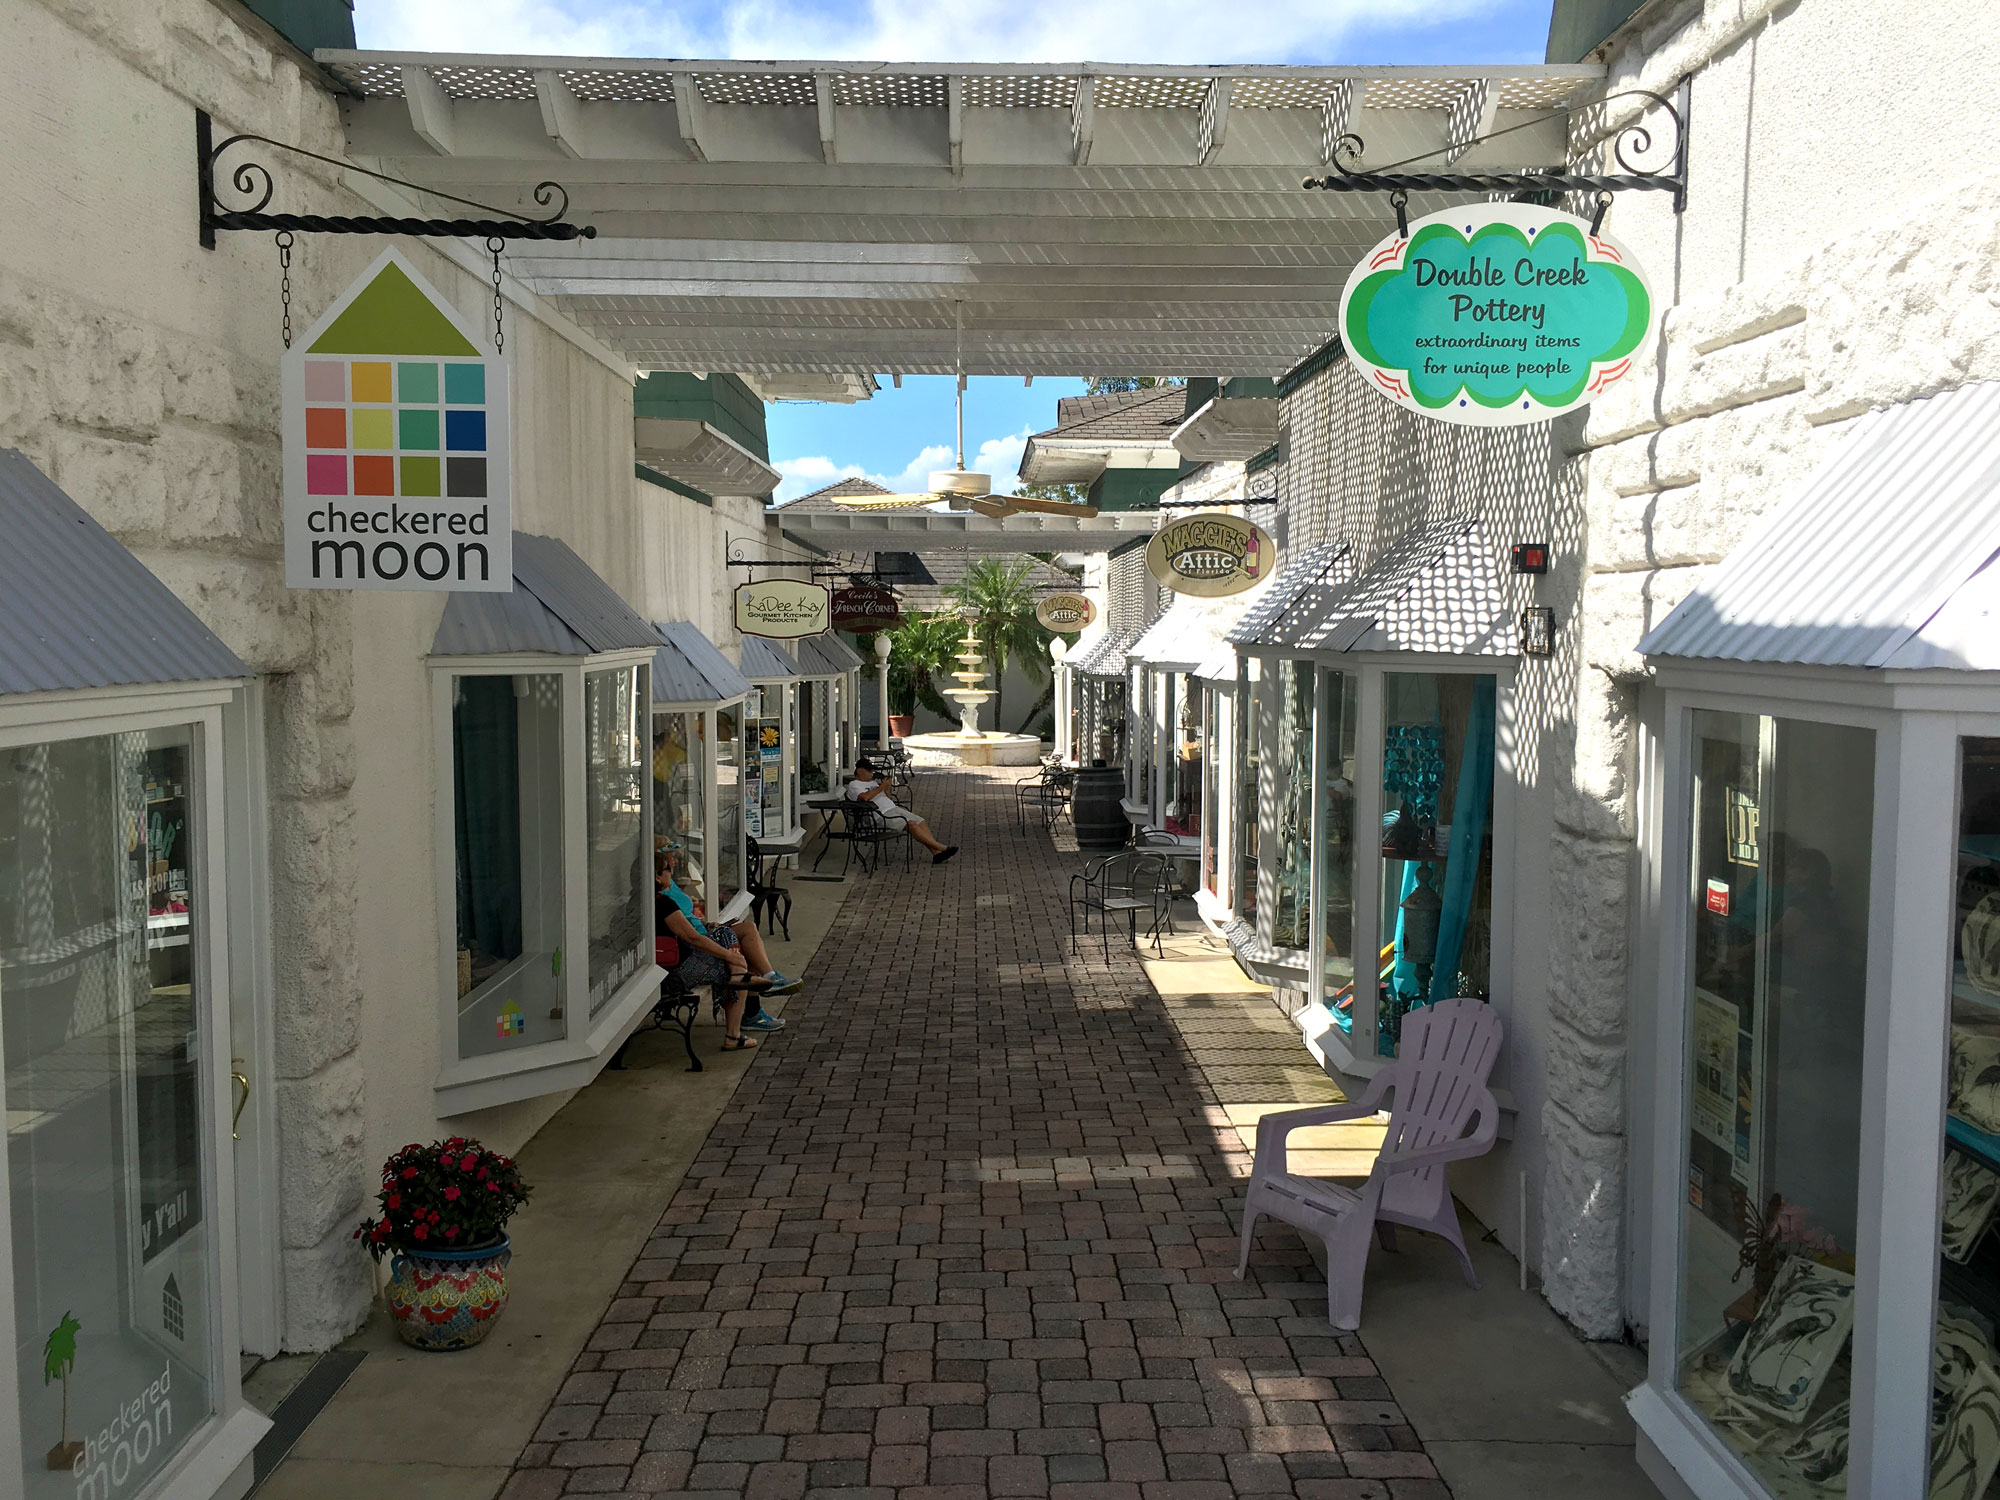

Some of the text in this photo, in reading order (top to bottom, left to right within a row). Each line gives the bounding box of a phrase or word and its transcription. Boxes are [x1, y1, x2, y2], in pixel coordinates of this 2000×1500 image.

[1413, 256, 1590, 287] Double Creek
[1448, 294, 1546, 330] Pottery
[1415, 332, 1581, 352] extraordinary items
[1424, 357, 1571, 379] for unique people
[307, 502, 489, 536] checkered
[312, 540, 489, 581] moon
[1179, 552, 1233, 569] Attic
[864, 600, 895, 615] CORNER
[1052, 610, 1077, 619] Attic
[73, 1360, 171, 1478] checkered
[77, 1399, 172, 1500] moon
